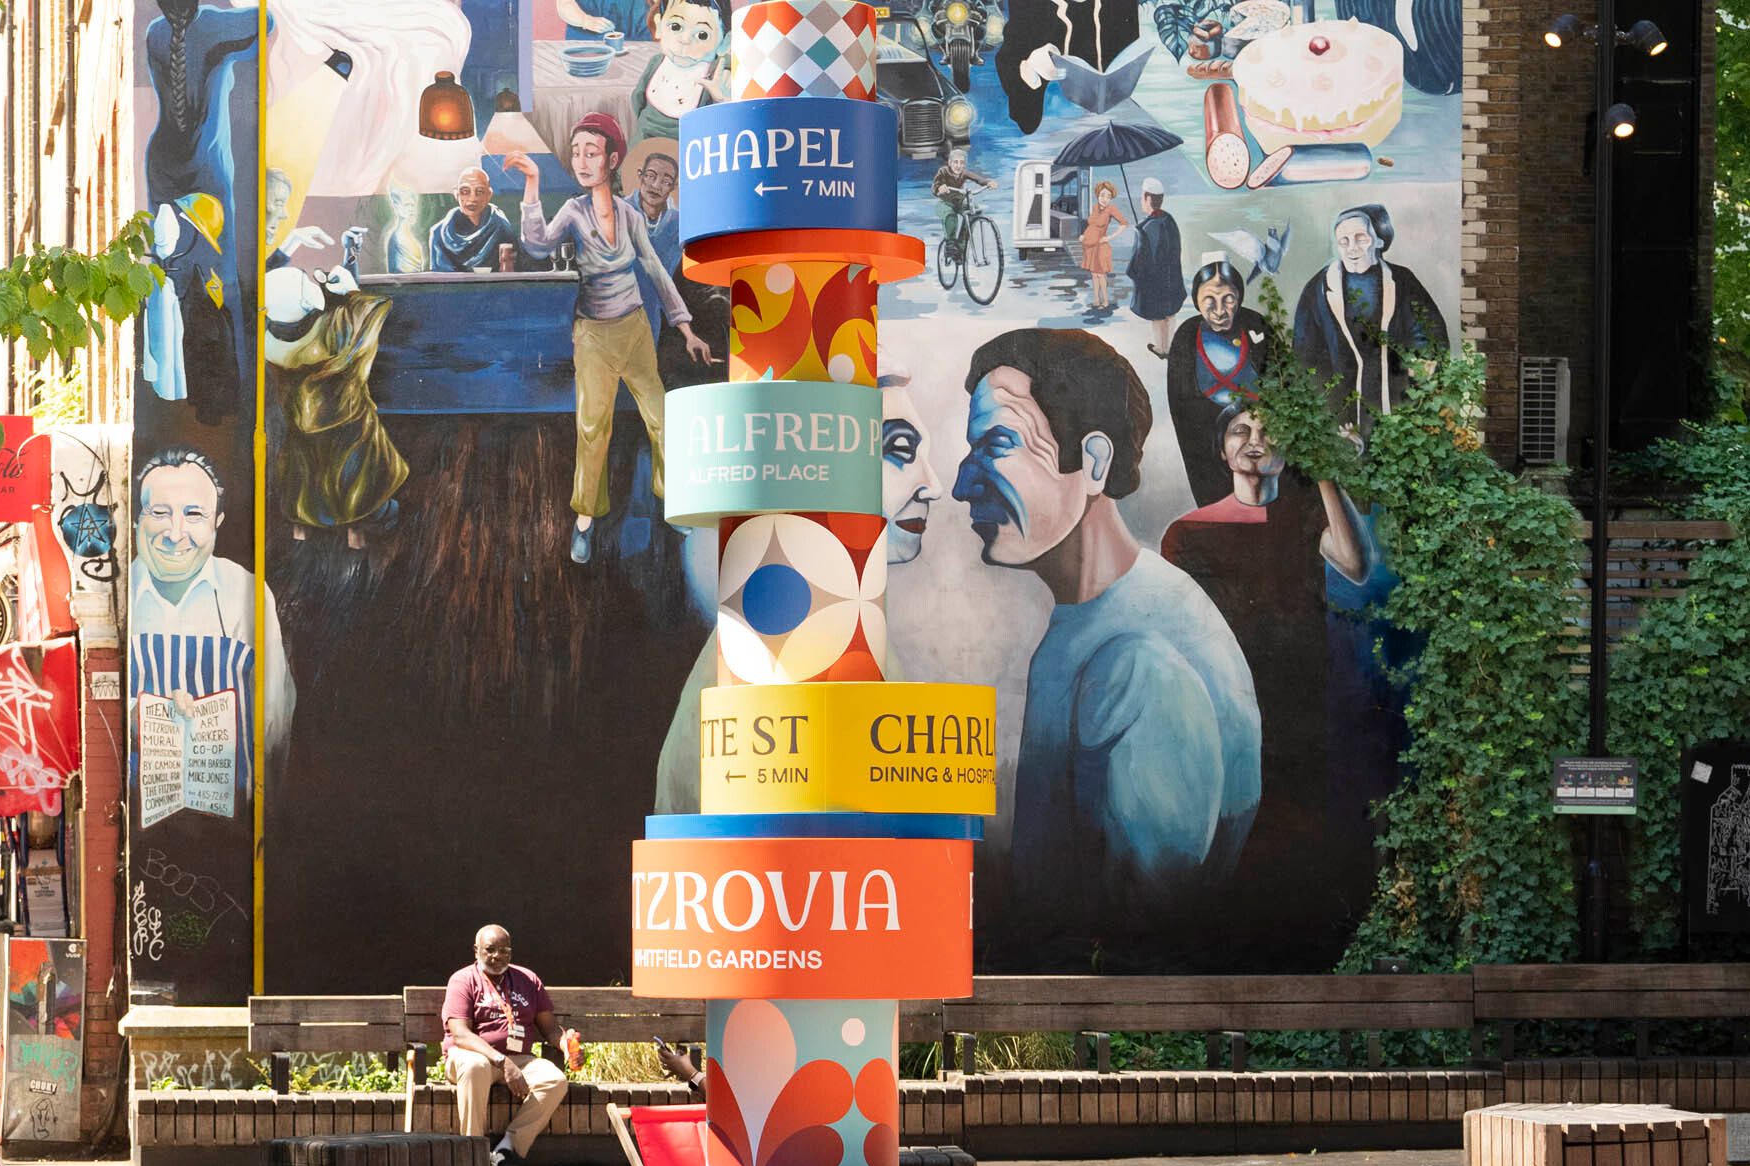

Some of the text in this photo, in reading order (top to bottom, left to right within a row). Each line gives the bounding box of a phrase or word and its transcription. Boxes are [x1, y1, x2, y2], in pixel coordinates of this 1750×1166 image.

[685, 127, 854, 180] CHAPEL
[802, 179, 856, 198] 7 MIN
[687, 412, 883, 457] ALFRED P
[687, 464, 830, 484] ALFRED PLACE
[220, 698, 230, 713] BY
[144, 720, 180, 735] FITZROVIA
[200, 717, 219, 728] ART
[143, 735, 177, 748] MURAL
[190, 730, 229, 743] WORKERS
[752, 714, 809, 756] ST
[870, 713, 996, 758] CHARL
[193, 744, 224, 755] CO-OP
[143, 760, 181, 771] BY CAMDEN
[188, 771, 230, 785] MIKE JONES
[757, 768, 767, 784] 5
[772, 767, 809, 783] MIN
[870, 766, 938, 783] DINING
[942, 767, 953, 783] &
[145, 786, 157, 798] THE
[634, 948, 823, 970] WHITFIELD GARDENS
